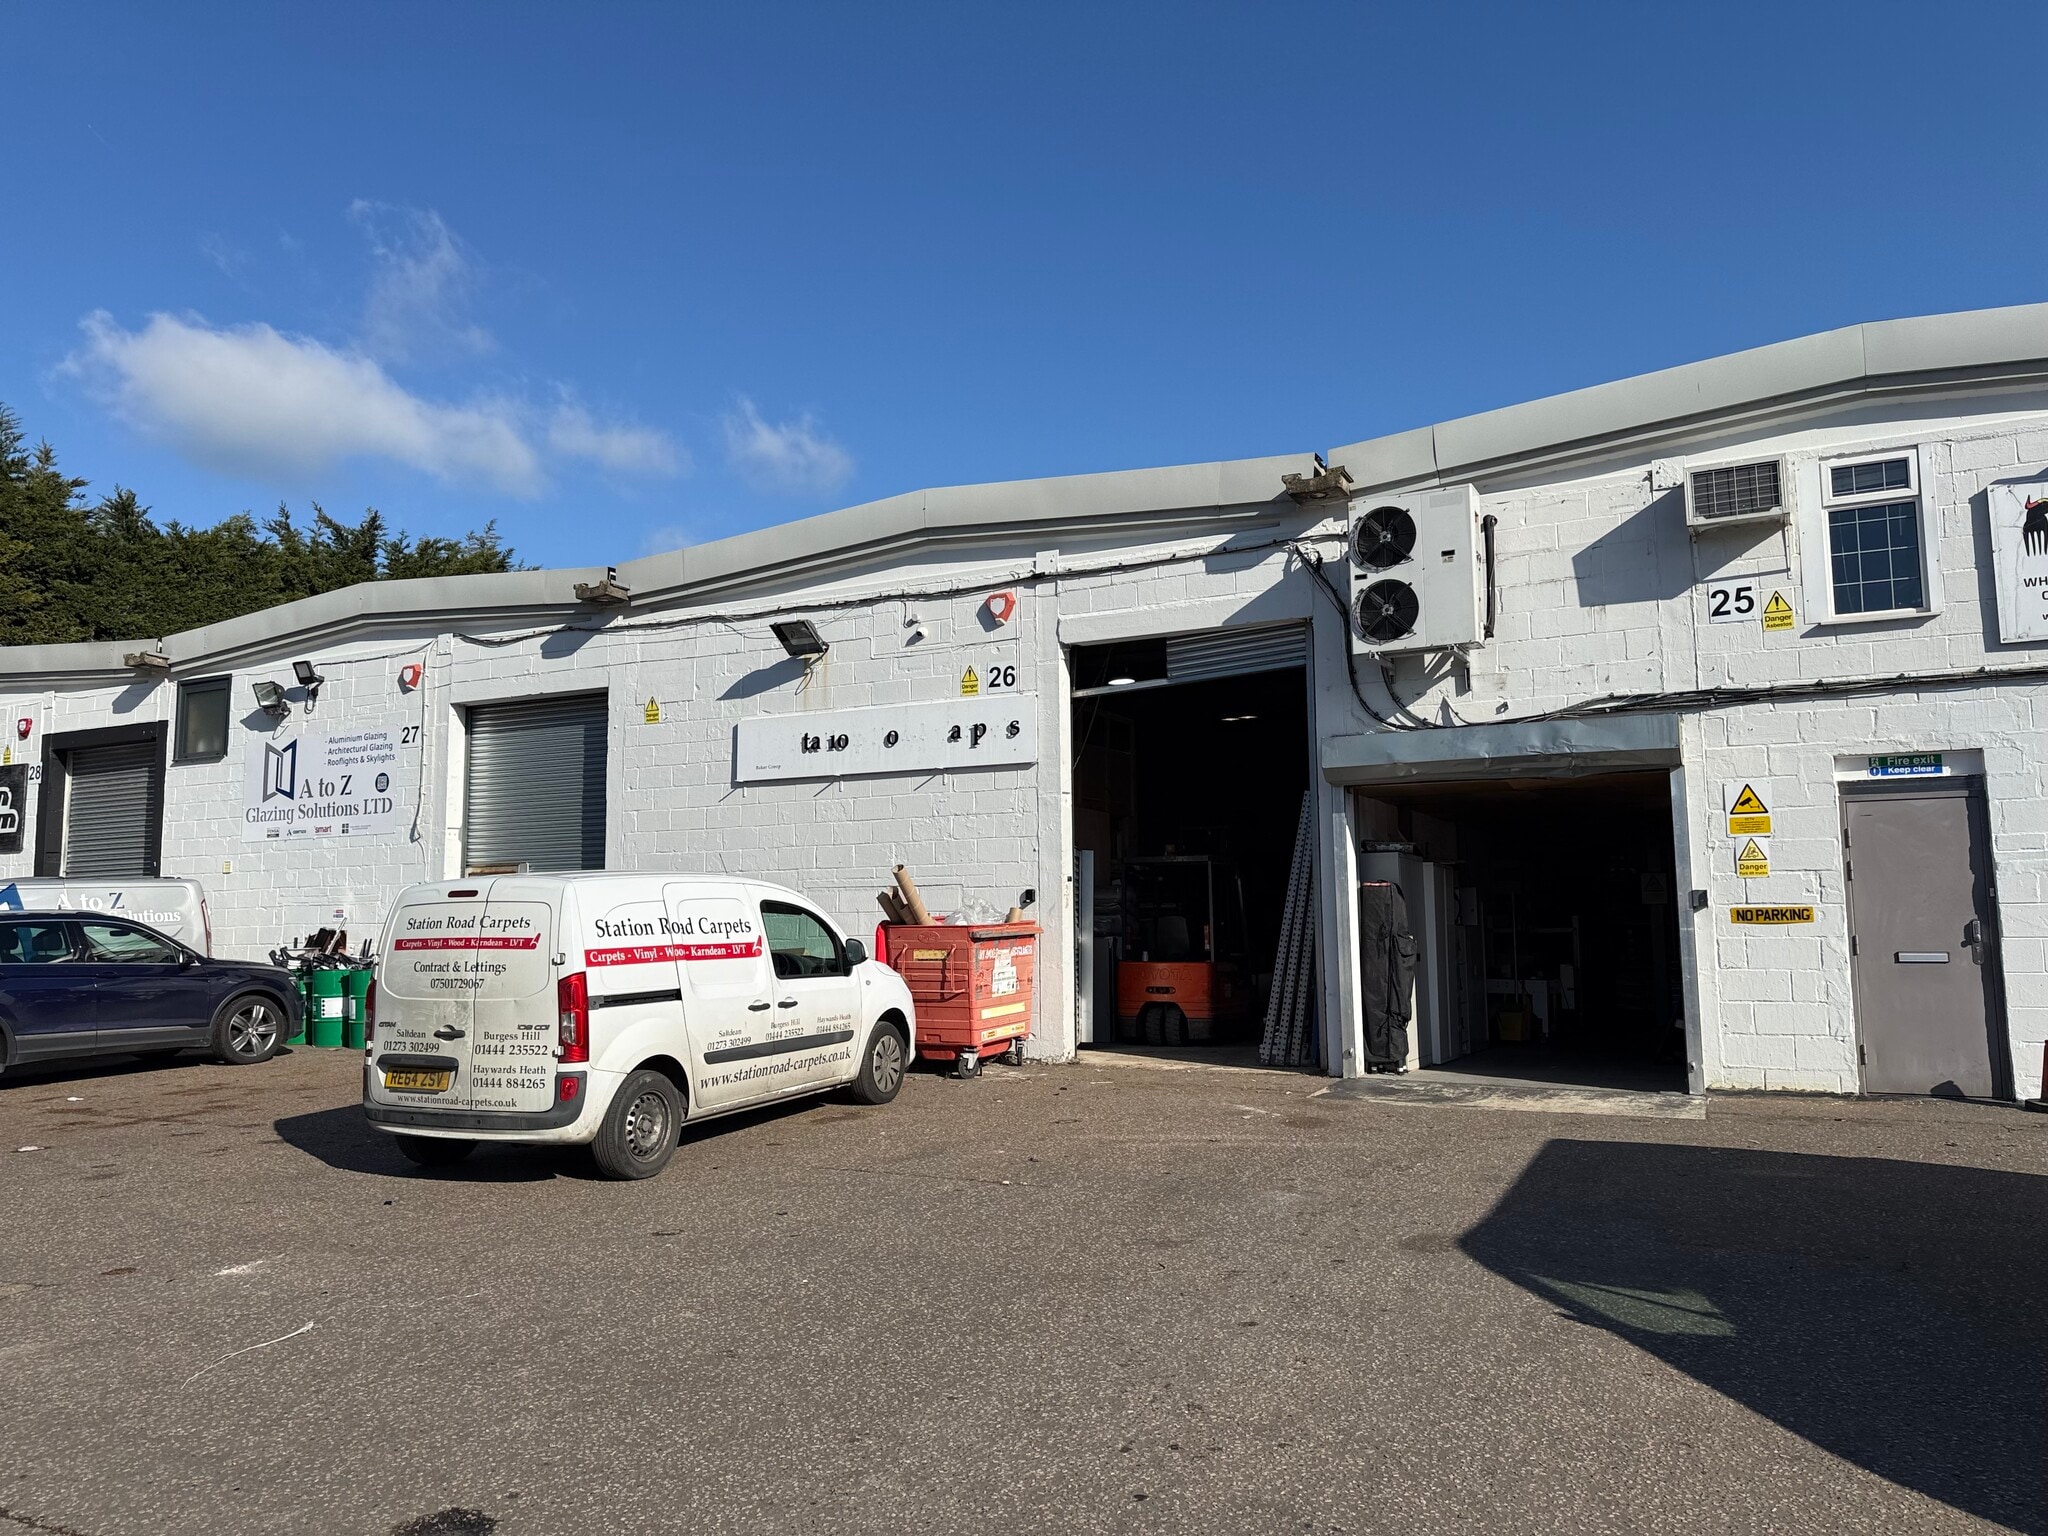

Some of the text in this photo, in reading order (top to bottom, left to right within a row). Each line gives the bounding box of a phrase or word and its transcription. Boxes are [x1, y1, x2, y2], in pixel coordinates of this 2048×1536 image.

[1710, 586, 1755, 618] 25
[1764, 614, 1792, 623] Danger
[1766, 621, 1793, 629] Asbestos
[988, 665, 1016, 688] 26
[328, 732, 388, 744] Aluminium Glazing
[401, 726, 420, 744] 27
[328, 742, 394, 755] Architectural Glazing
[327, 753, 396, 767] Rooflights & Skylights
[1887, 754, 1936, 766] Fire exit
[28, 765, 41, 781] 28
[1887, 765, 1936, 776] Keep clear
[299, 774, 353, 799] A to Z
[245, 797, 393, 825] Glazing Solutions LTD
[1739, 863, 1768, 871] Danger
[56, 892, 125, 910] A to Z
[1736, 906, 1811, 921] NO PARKING
[406, 915, 531, 932] Station Road Carpets
[594, 918, 655, 938] Station
[698, 916, 752, 939] Carpets
[401, 939, 423, 949] Carpets
[427, 938, 443, 948] Vinyl
[448, 938, 465, 947] Wood
[470, 938, 504, 947] Karndean
[509, 938, 525, 947] LVT
[589, 950, 626, 965] Carpets
[634, 947, 658, 962] Vinyl
[691, 945, 727, 957] Karndean
[732, 944, 747, 955] LVT
[413, 961, 507, 976] Contract & Lettings
[430, 978, 485, 989] 07501729067
[396, 1028, 427, 1039] Saltdean
[483, 1031, 541, 1042] Burgess Hill
[718, 1028, 742, 1038] Saltdean
[765, 1030, 783, 1041] 01444
[383, 1040, 440, 1053] 01273 302499
[707, 1036, 752, 1051] 01273 302499
[474, 1045, 548, 1056] 01444 235522
[473, 1064, 547, 1077] Haywards Heath
[700, 1047, 852, 1090] www.stationroad-carpets.co.uk
[390, 1070, 444, 1088] RE64 ZSV
[472, 1077, 546, 1089] 01444 884265
[397, 1094, 518, 1109] www.stationroad-carpets.co.uk
